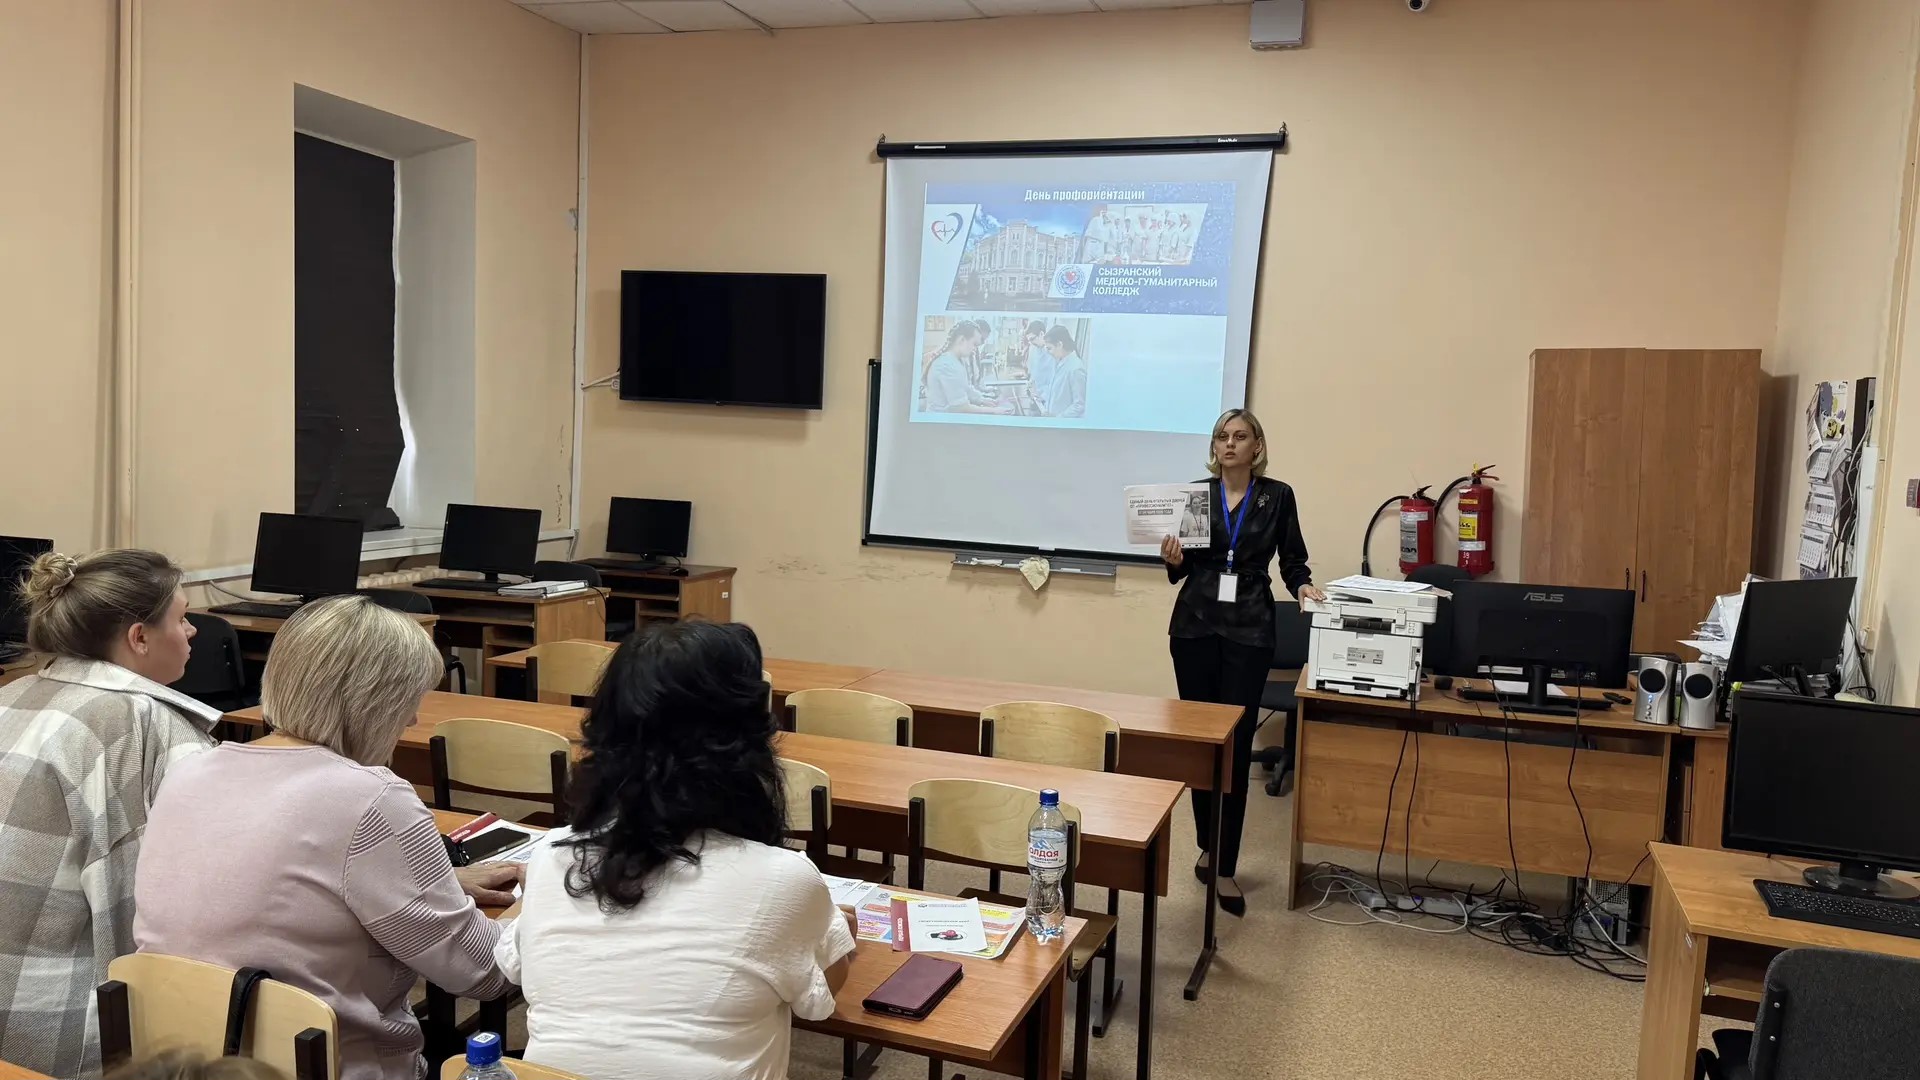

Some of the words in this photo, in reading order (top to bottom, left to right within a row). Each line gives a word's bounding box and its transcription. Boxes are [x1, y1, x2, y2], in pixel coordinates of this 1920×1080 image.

[1024, 189, 1051, 202] День
[1053, 189, 1146, 202] профориентации
[1098, 266, 1162, 277] СЫЗРАНСКИЙ
[1095, 277, 1218, 288] МЕДИКО-ГУМАНИТАРНЫЙ
[1092, 286, 1140, 296] КОЛЛЕДЖ
[1523, 592, 1564, 603] ASUS
[1029, 847, 1059, 858] алдая
